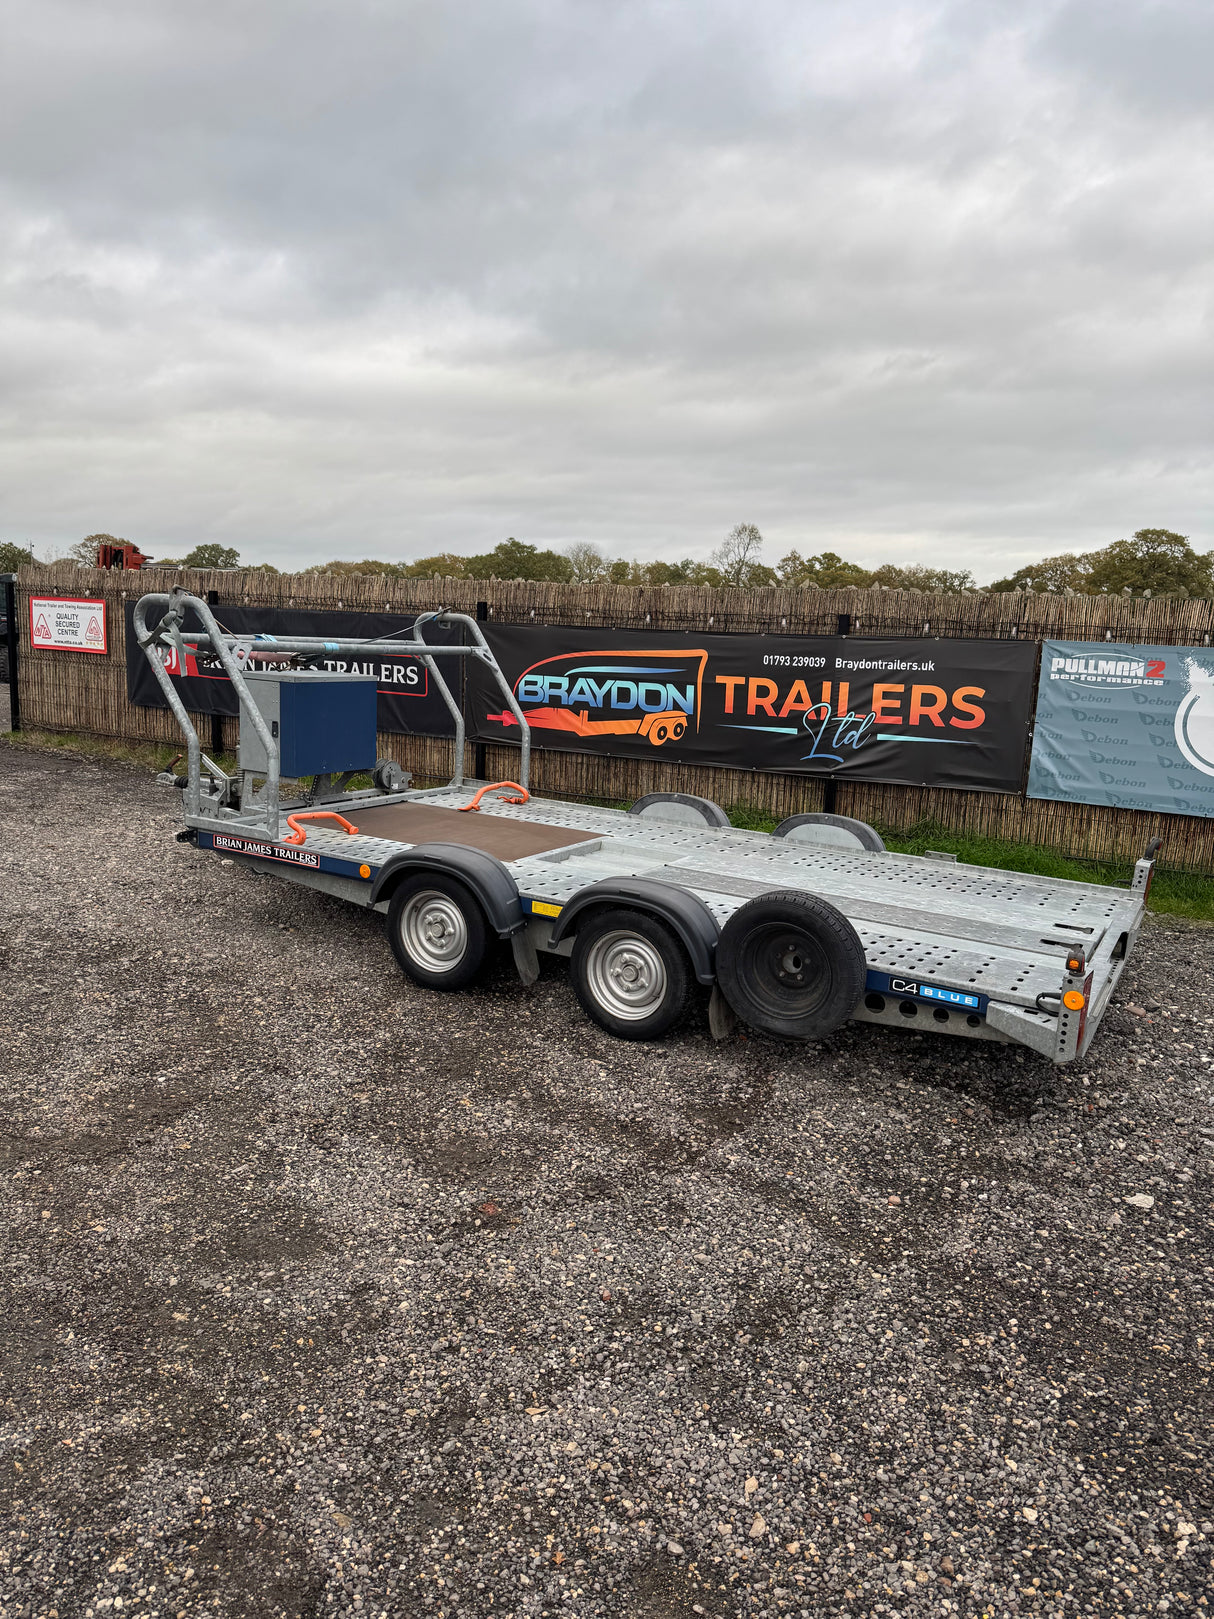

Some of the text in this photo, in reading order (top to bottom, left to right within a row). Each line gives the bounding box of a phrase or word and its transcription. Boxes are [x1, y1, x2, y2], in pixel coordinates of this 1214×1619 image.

[55, 621, 80, 629] SECURED
[56, 613, 79, 621] QUALITY
[57, 629, 79, 637] CENTRE
[763, 655, 826, 668] 01793 239039
[835, 658, 935, 671] Braydontrailers.uk
[1051, 657, 1166, 679] PULLMAN 2
[323, 660, 419, 685] TRAILERS
[1050, 673, 1164, 686] performance
[518, 674, 695, 715] BRAYDON
[715, 675, 986, 730] TRAILERS
[1065, 688, 1112, 704] Debon
[1071, 708, 1119, 725] Debon
[800, 702, 876, 763] Ltd
[1080, 729, 1129, 746] Debon
[1089, 750, 1137, 767] Debon
[1098, 771, 1147, 788] Debon
[216, 836, 243, 850] BRIAN
[243, 842, 272, 856] JAMES
[274, 847, 318, 865] TRAILERS
[892, 979, 974, 1005] C4 BLUE
